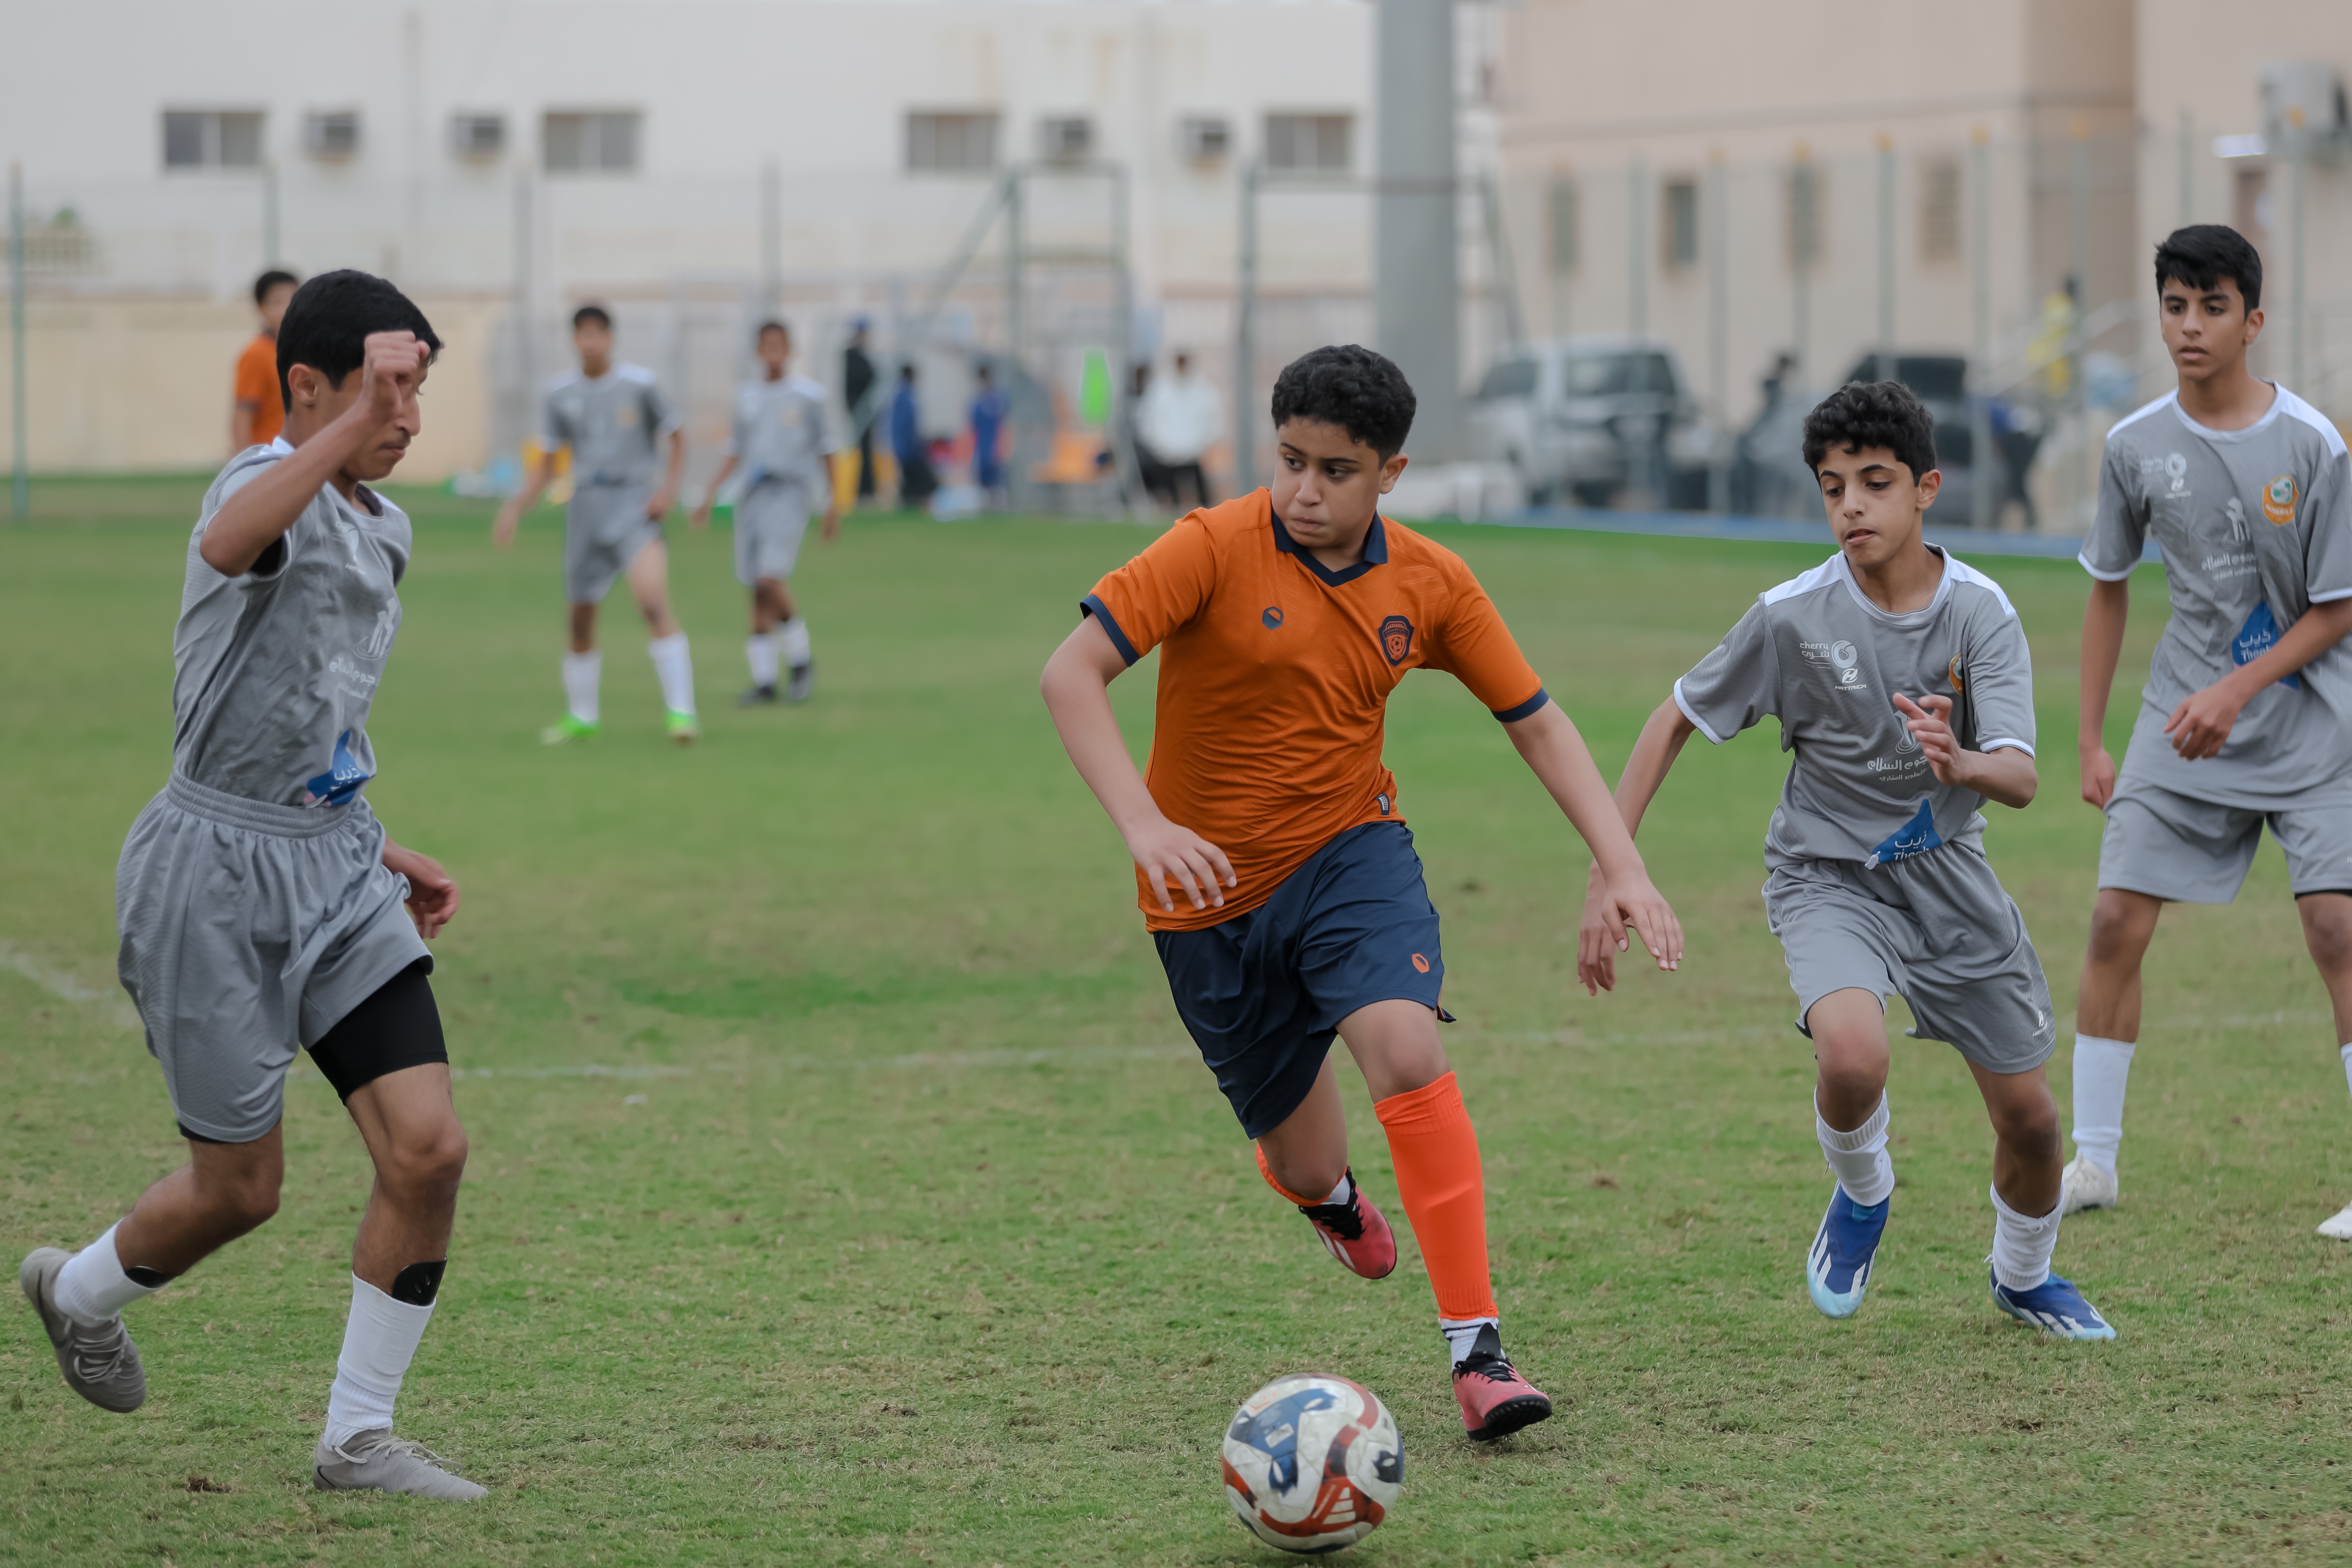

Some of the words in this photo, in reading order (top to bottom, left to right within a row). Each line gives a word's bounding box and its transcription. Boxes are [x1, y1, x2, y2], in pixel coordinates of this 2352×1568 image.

[1799, 641, 1829, 650] cherry
[1867, 757, 1902, 772] السلام
[1904, 756, 1928, 770] جوم
